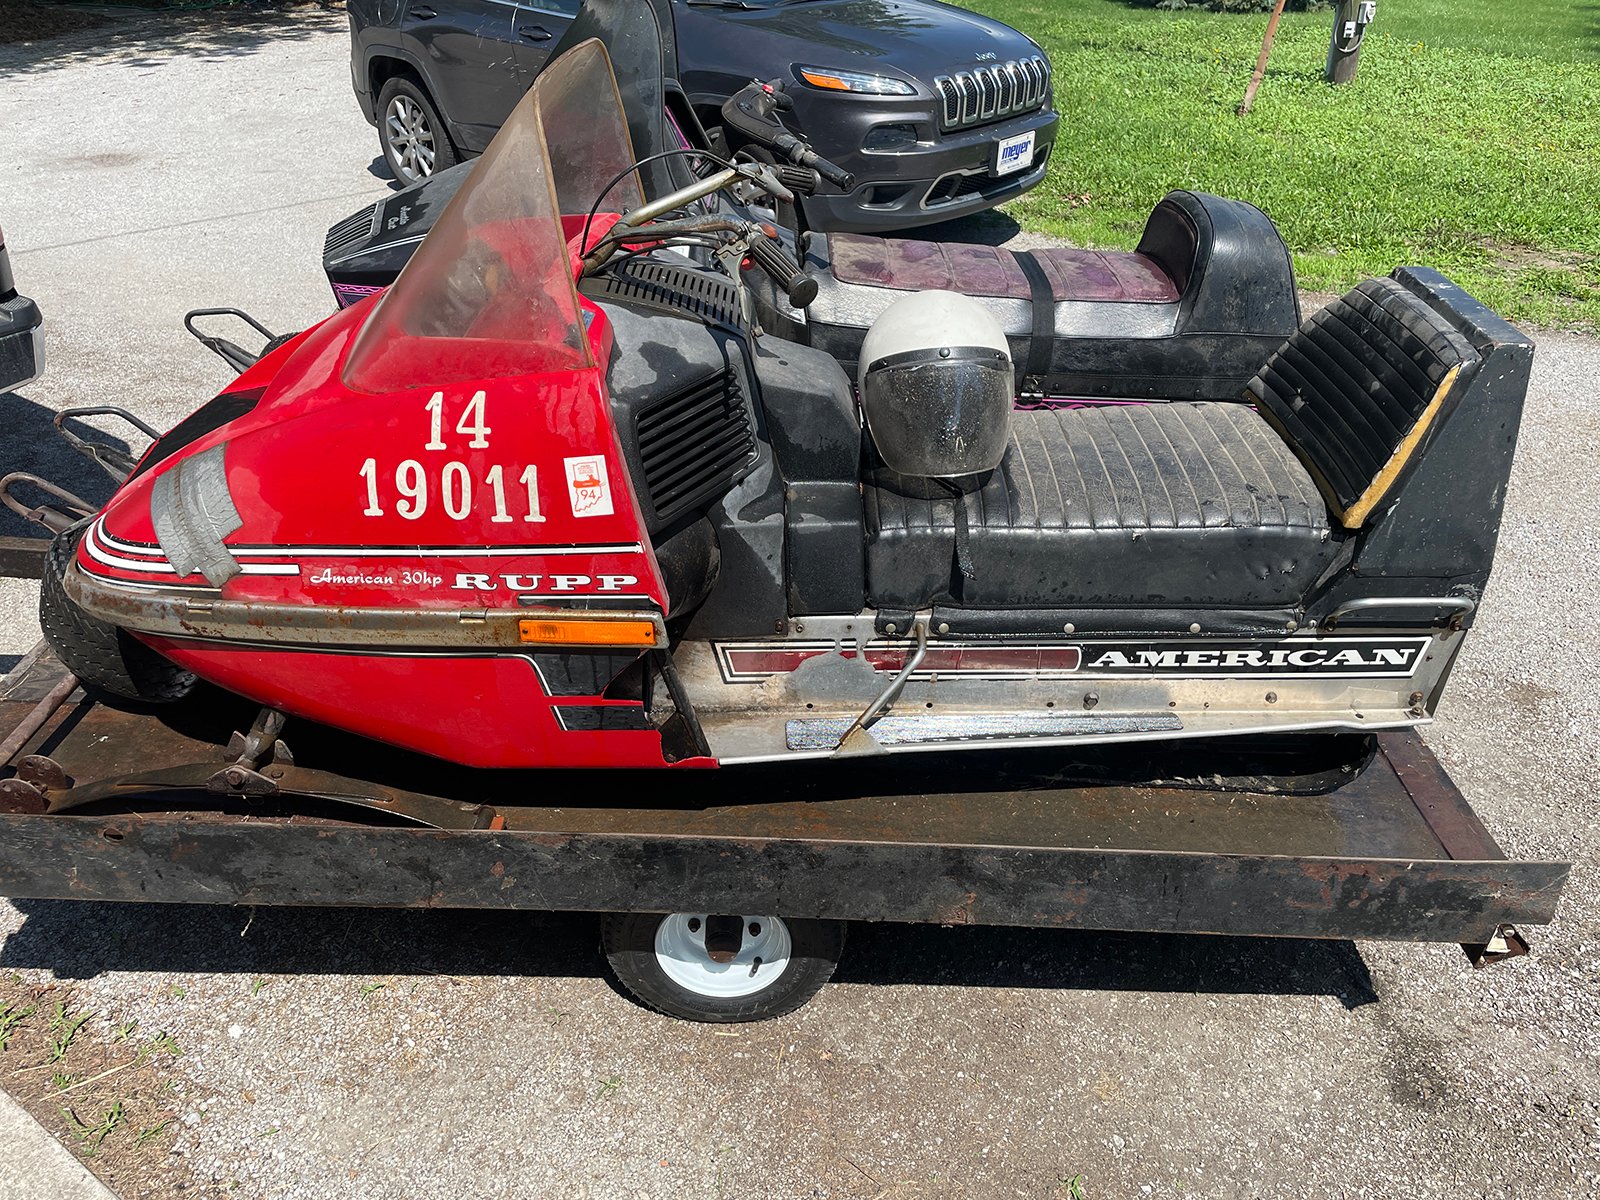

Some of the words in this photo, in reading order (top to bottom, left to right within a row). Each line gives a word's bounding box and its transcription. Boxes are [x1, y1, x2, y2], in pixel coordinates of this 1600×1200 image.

[1002, 140, 1031, 161] meyer
[425, 390, 492, 451] 14
[359, 457, 547, 523] 19011
[580, 489, 596, 501] 94
[310, 568, 394, 585] American
[402, 571, 442, 587] 30hp
[451, 573, 638, 591] RUPP
[1088, 648, 1416, 668] AMERICAN
